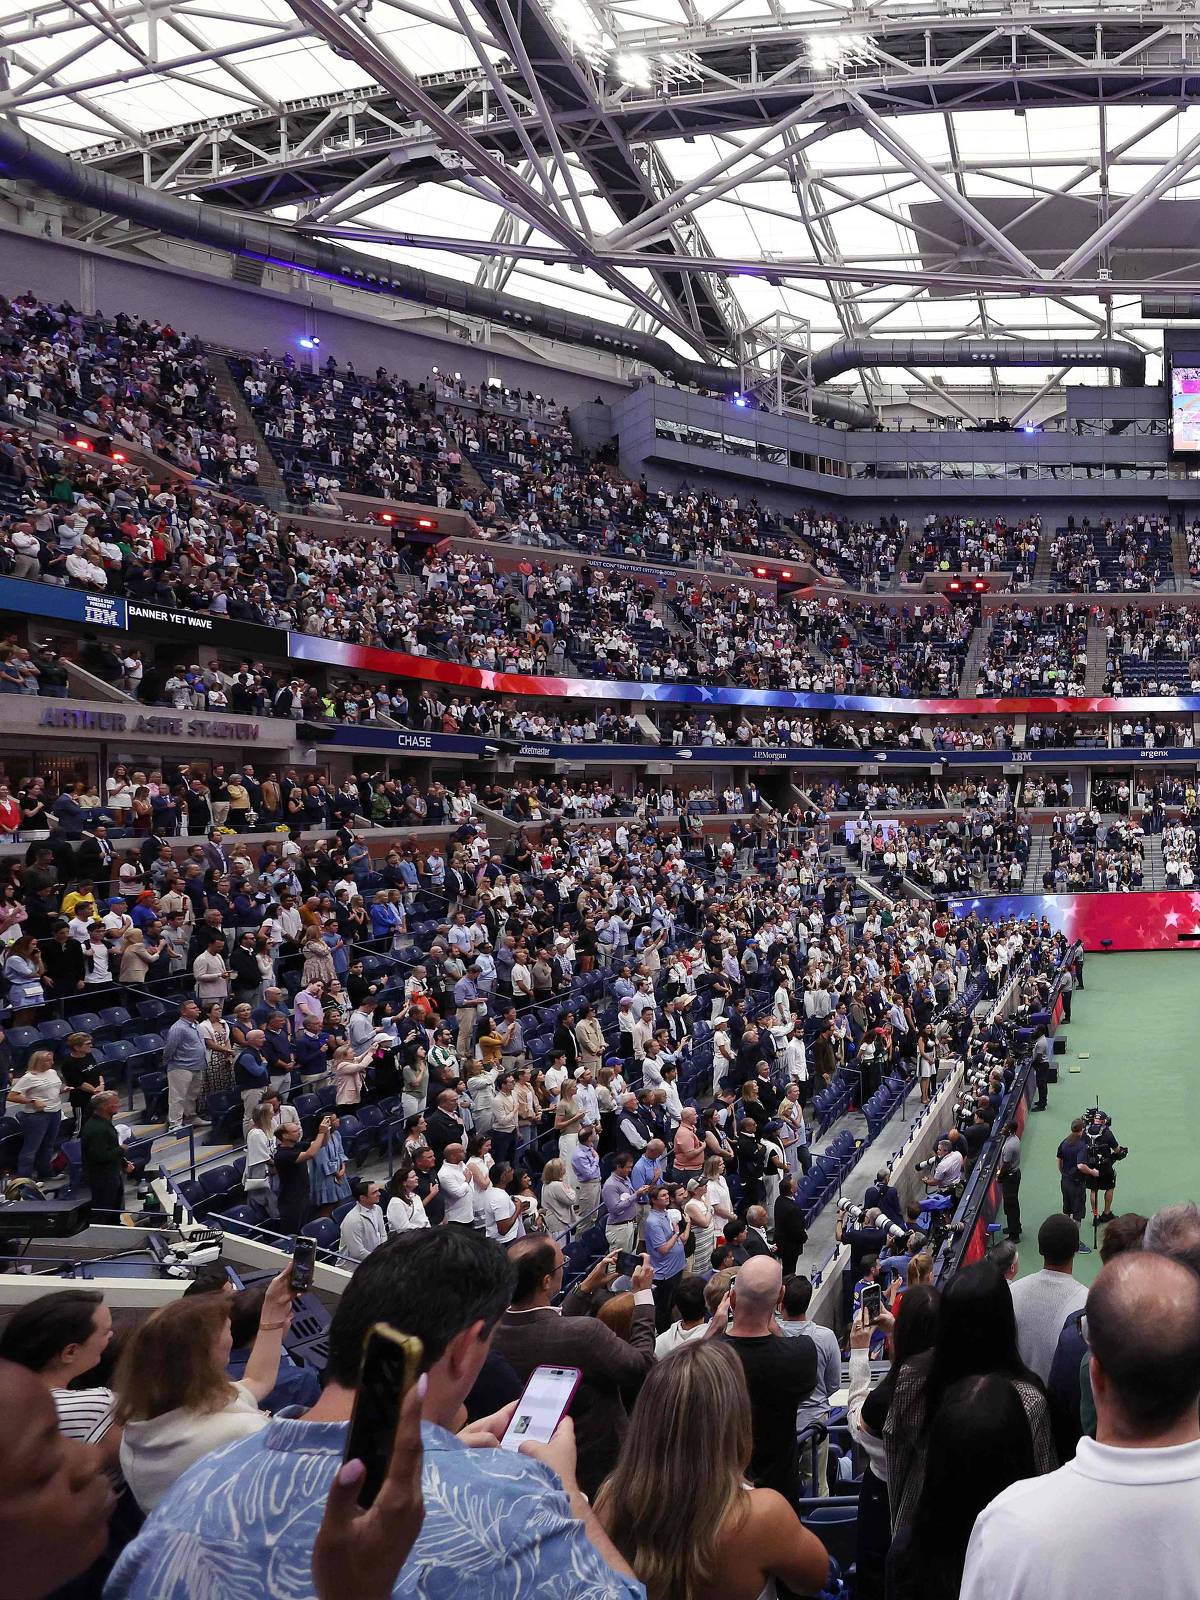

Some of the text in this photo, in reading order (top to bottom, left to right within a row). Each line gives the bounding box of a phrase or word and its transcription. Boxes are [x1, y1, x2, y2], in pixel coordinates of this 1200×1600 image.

[85, 606, 119, 626] IBM
[128, 606, 213, 629] BANNER YET WAVE
[39, 707, 260, 741] ARTHUR ASHE STADIUM
[398, 735, 432, 748] CHASE
[1011, 752, 1032, 761] IBM
[1140, 749, 1169, 759] argenx
